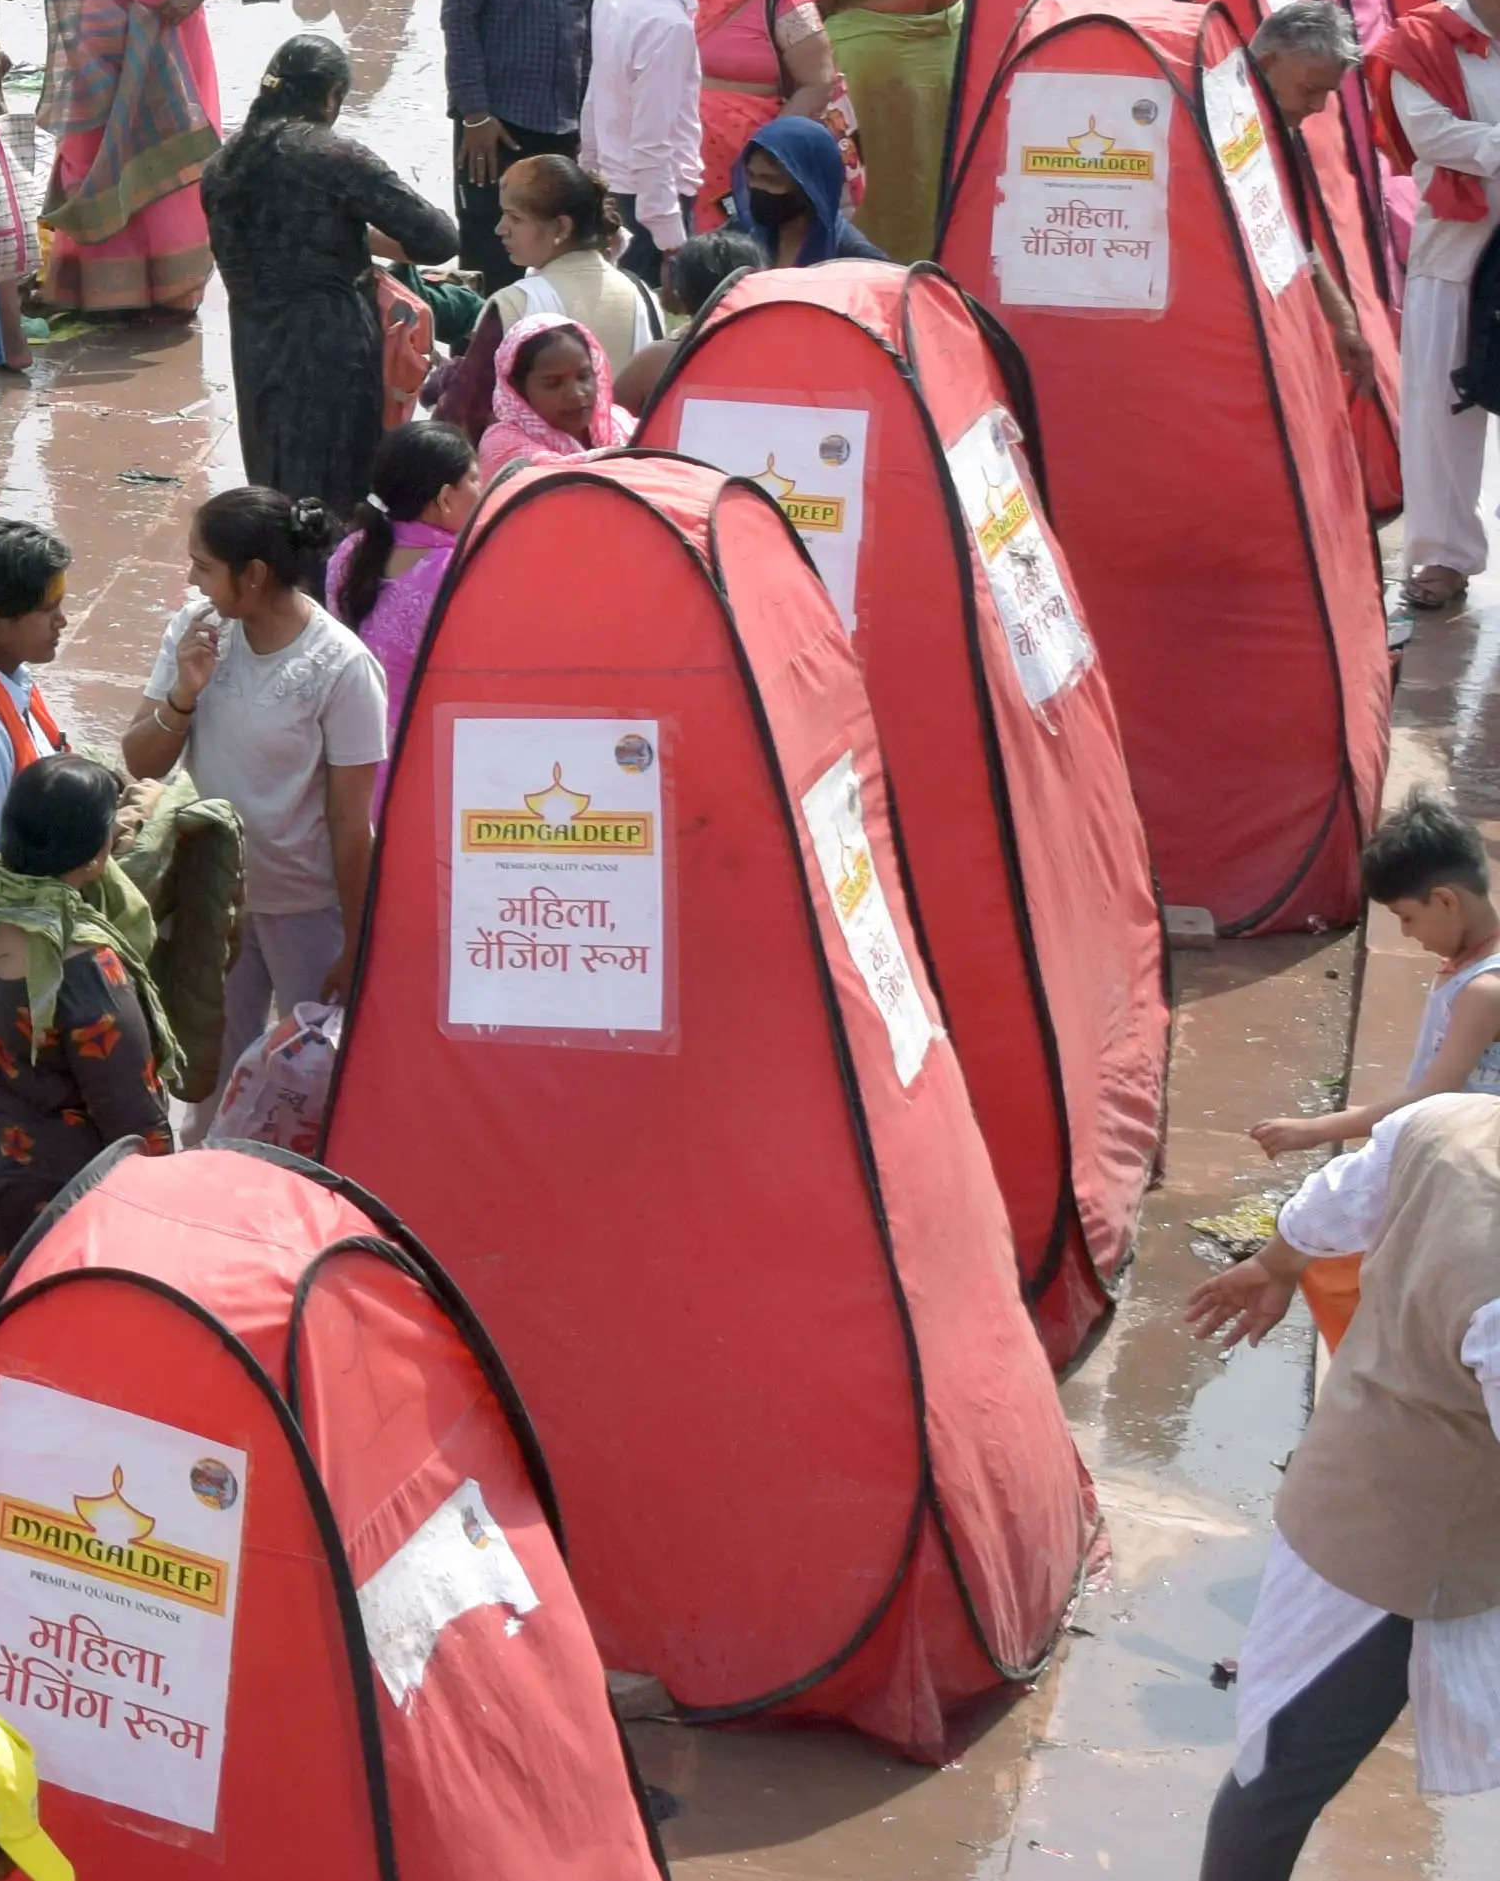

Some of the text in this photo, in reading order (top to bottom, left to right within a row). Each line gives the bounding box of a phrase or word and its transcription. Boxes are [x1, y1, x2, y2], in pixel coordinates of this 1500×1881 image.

[1031, 154, 1148, 172] MANGALDEEP
[1045, 199, 1130, 231] महिला,
[1021, 226, 1153, 260] चेंजिंग रूम
[476, 822, 642, 843] MANGALDEEP
[497, 885, 617, 932] महिला,
[465, 926, 652, 975] चेंजिंग रूम
[9, 1513, 213, 1593] MANGALDEEP
[29, 1569, 182, 1624] PREMIUM QUALITY INCENSE
[28, 1613, 171, 1697] महिला,
[123, 1700, 211, 1761] रूम
